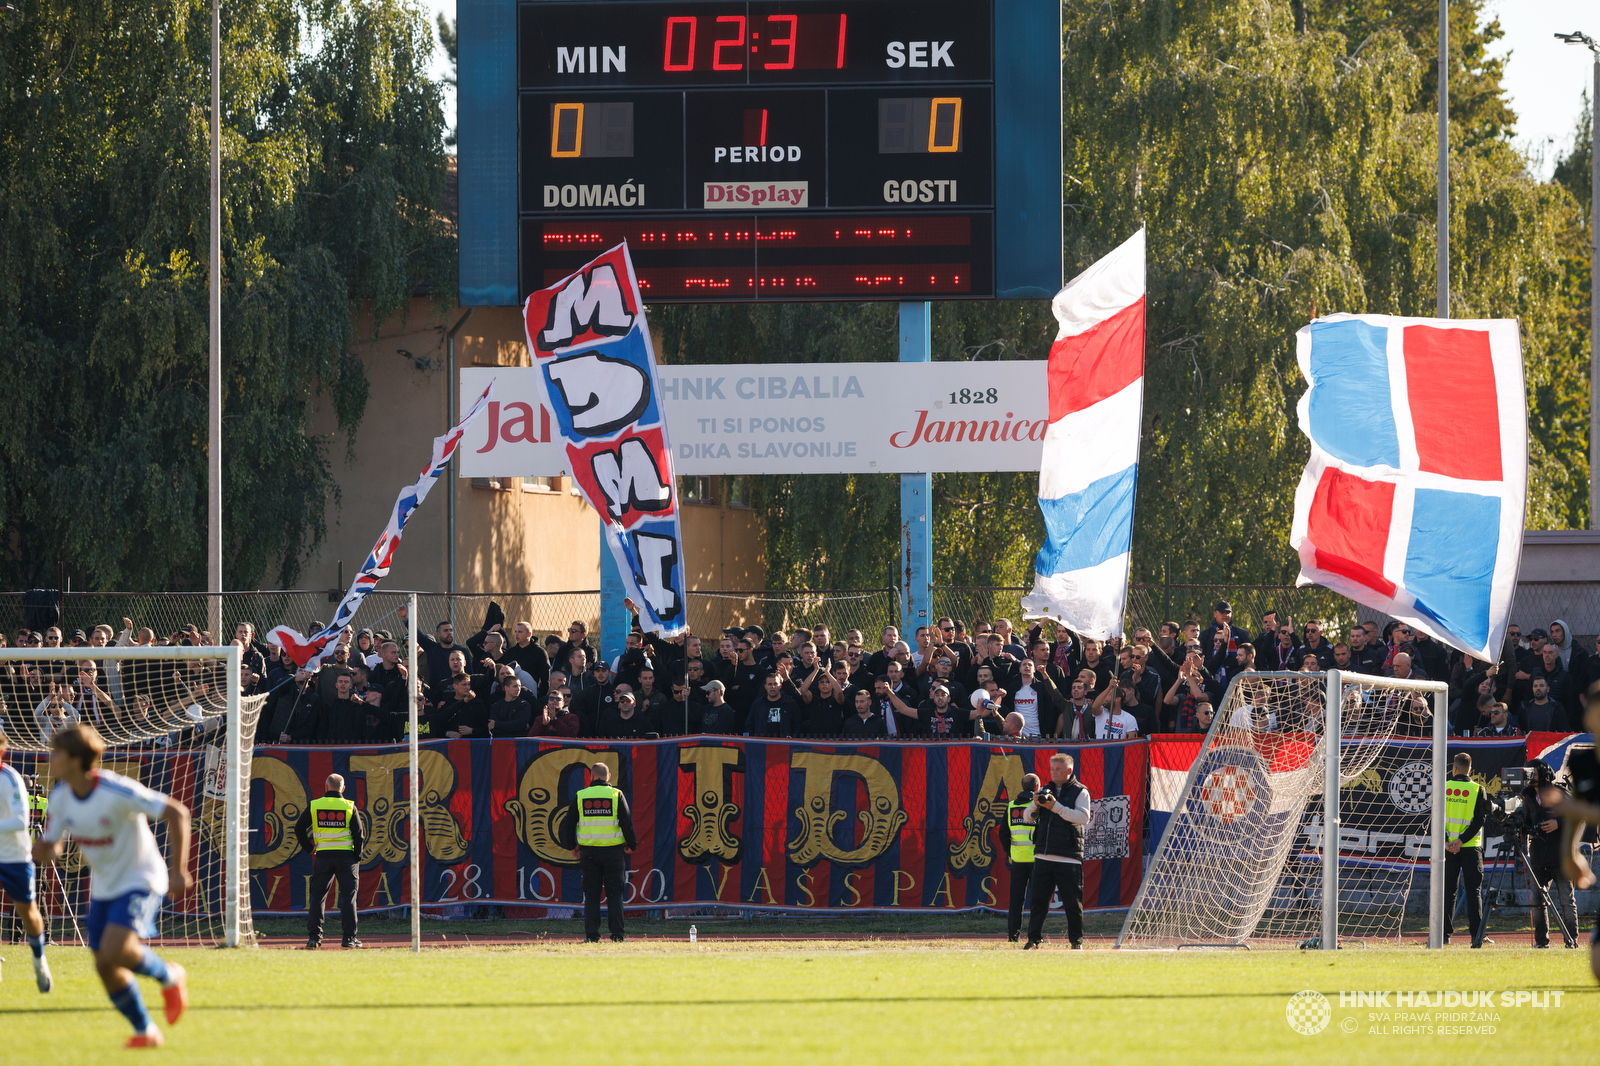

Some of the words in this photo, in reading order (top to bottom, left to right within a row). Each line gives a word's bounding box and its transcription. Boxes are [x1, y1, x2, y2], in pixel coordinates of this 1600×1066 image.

[663, 14, 847, 72] 02:31
[885, 40, 955, 69] SEK
[556, 46, 626, 74] MIN
[551, 103, 584, 158] 0
[760, 109, 768, 146] 1
[928, 97, 962, 153] 0
[714, 145, 801, 163] PERIOD
[543, 178, 645, 207] DOMAĆI
[706, 184, 806, 206] DiSplay
[883, 180, 957, 203] GOSTI
[660, 377, 726, 401] HNK
[735, 375, 865, 400] CIBALIA
[949, 388, 998, 404] 1828
[697, 418, 716, 434] TI
[723, 417, 742, 434] SI
[750, 416, 825, 433] PONOS
[889, 410, 1049, 449] Jamnica
[679, 443, 731, 459] DIKA
[737, 441, 857, 459] SLAVONIJE
[318, 820, 346, 828] SECURITAS
[438, 864, 490, 903] 28.
[516, 866, 559, 903] 10.
